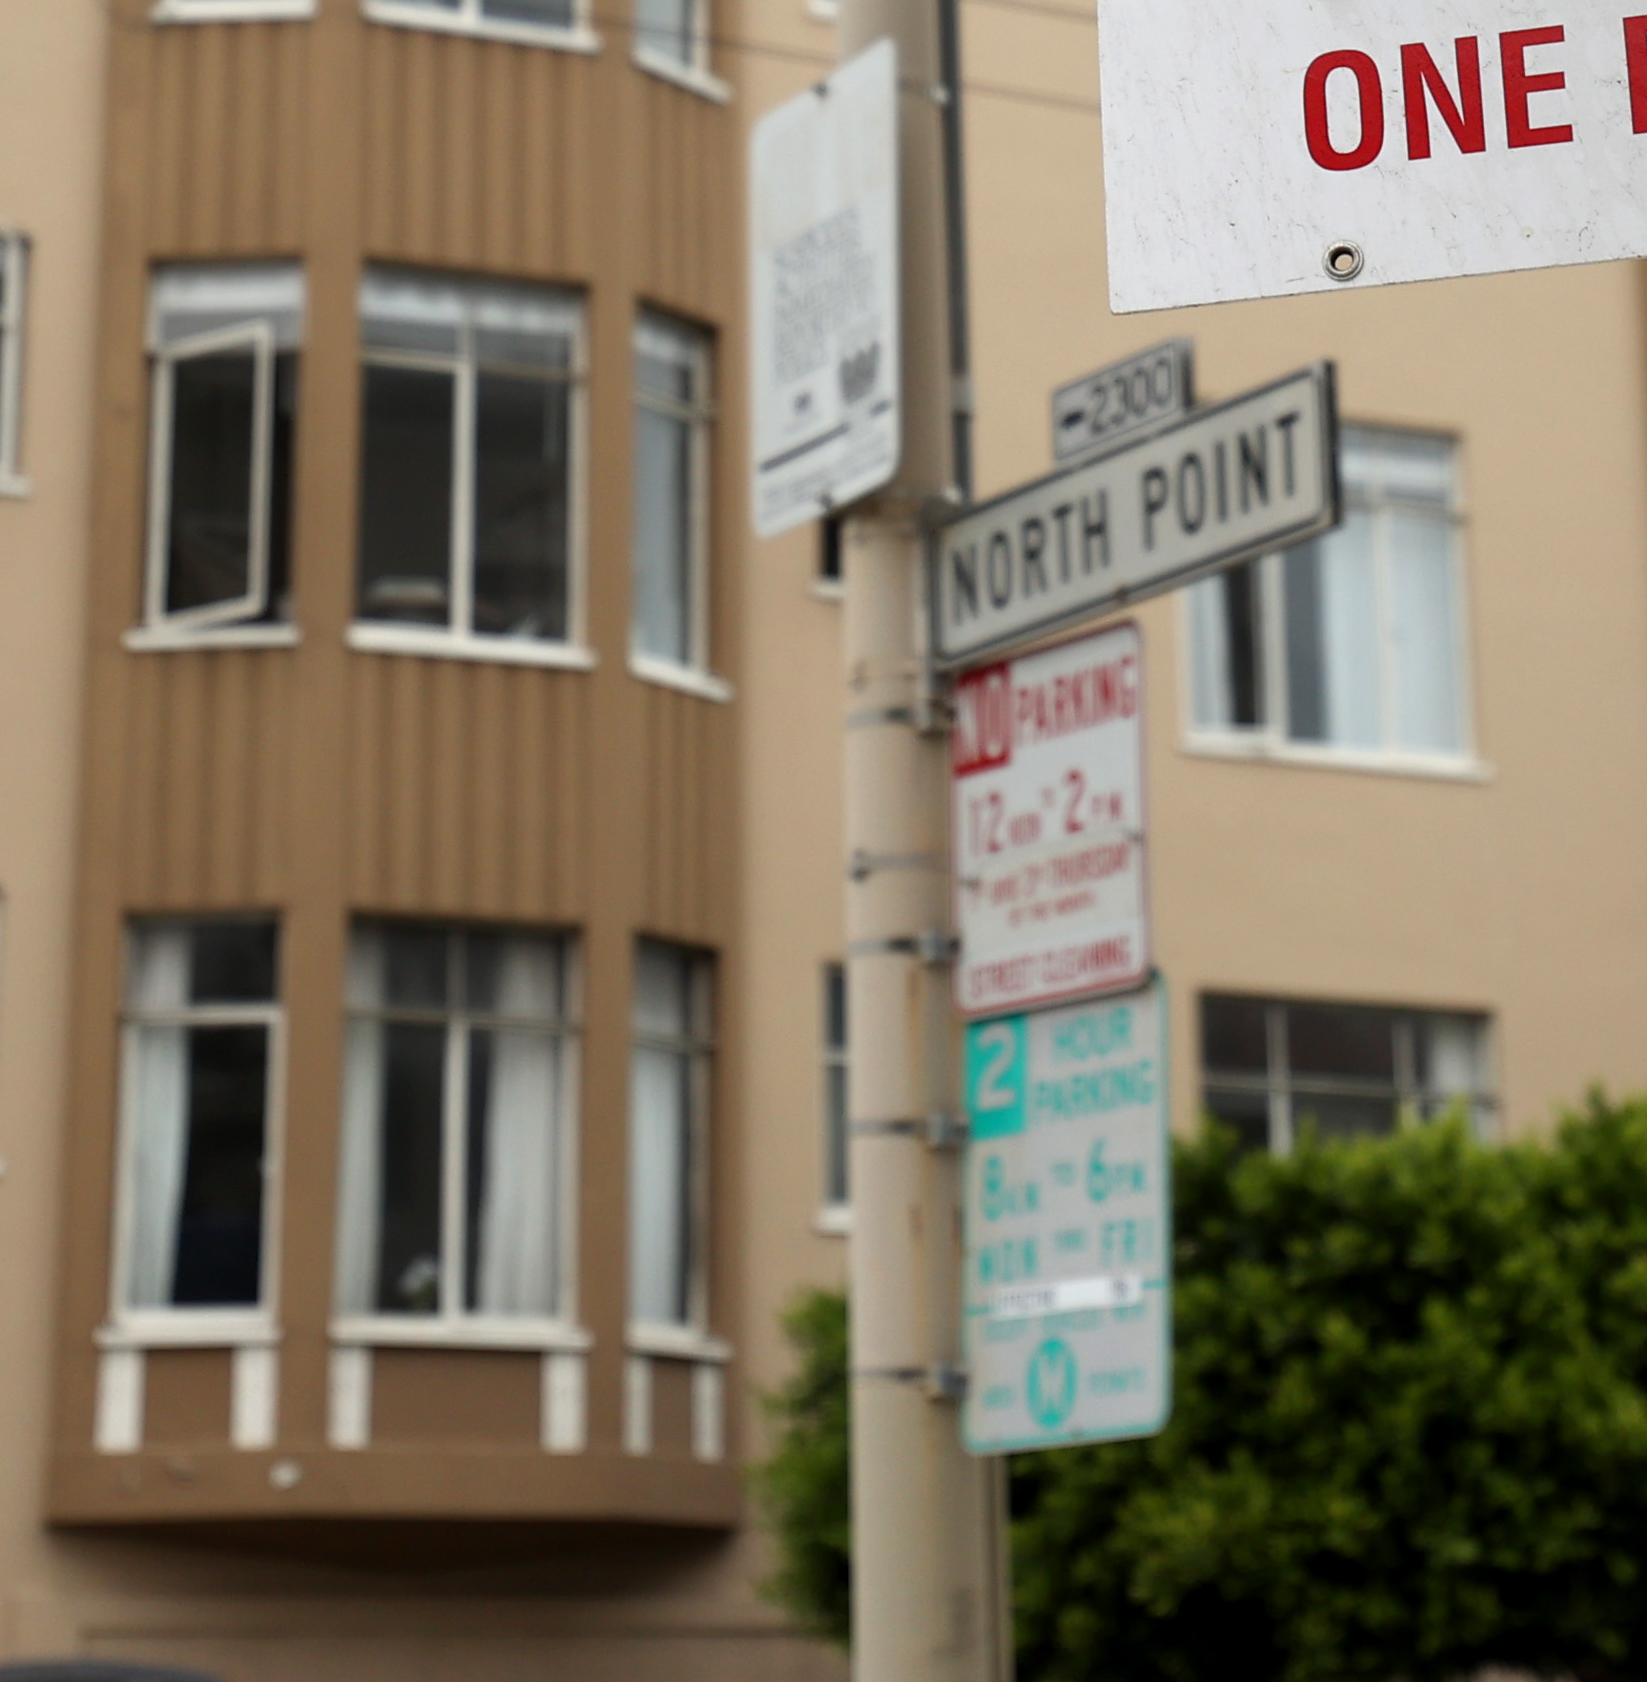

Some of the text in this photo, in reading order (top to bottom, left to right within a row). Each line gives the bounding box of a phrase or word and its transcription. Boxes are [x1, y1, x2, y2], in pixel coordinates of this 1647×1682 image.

[1301, 24, 1574, 172] ONE
[1090, 358, 1172, 436] 2300
[951, 410, 1301, 626] NORTH POINT
